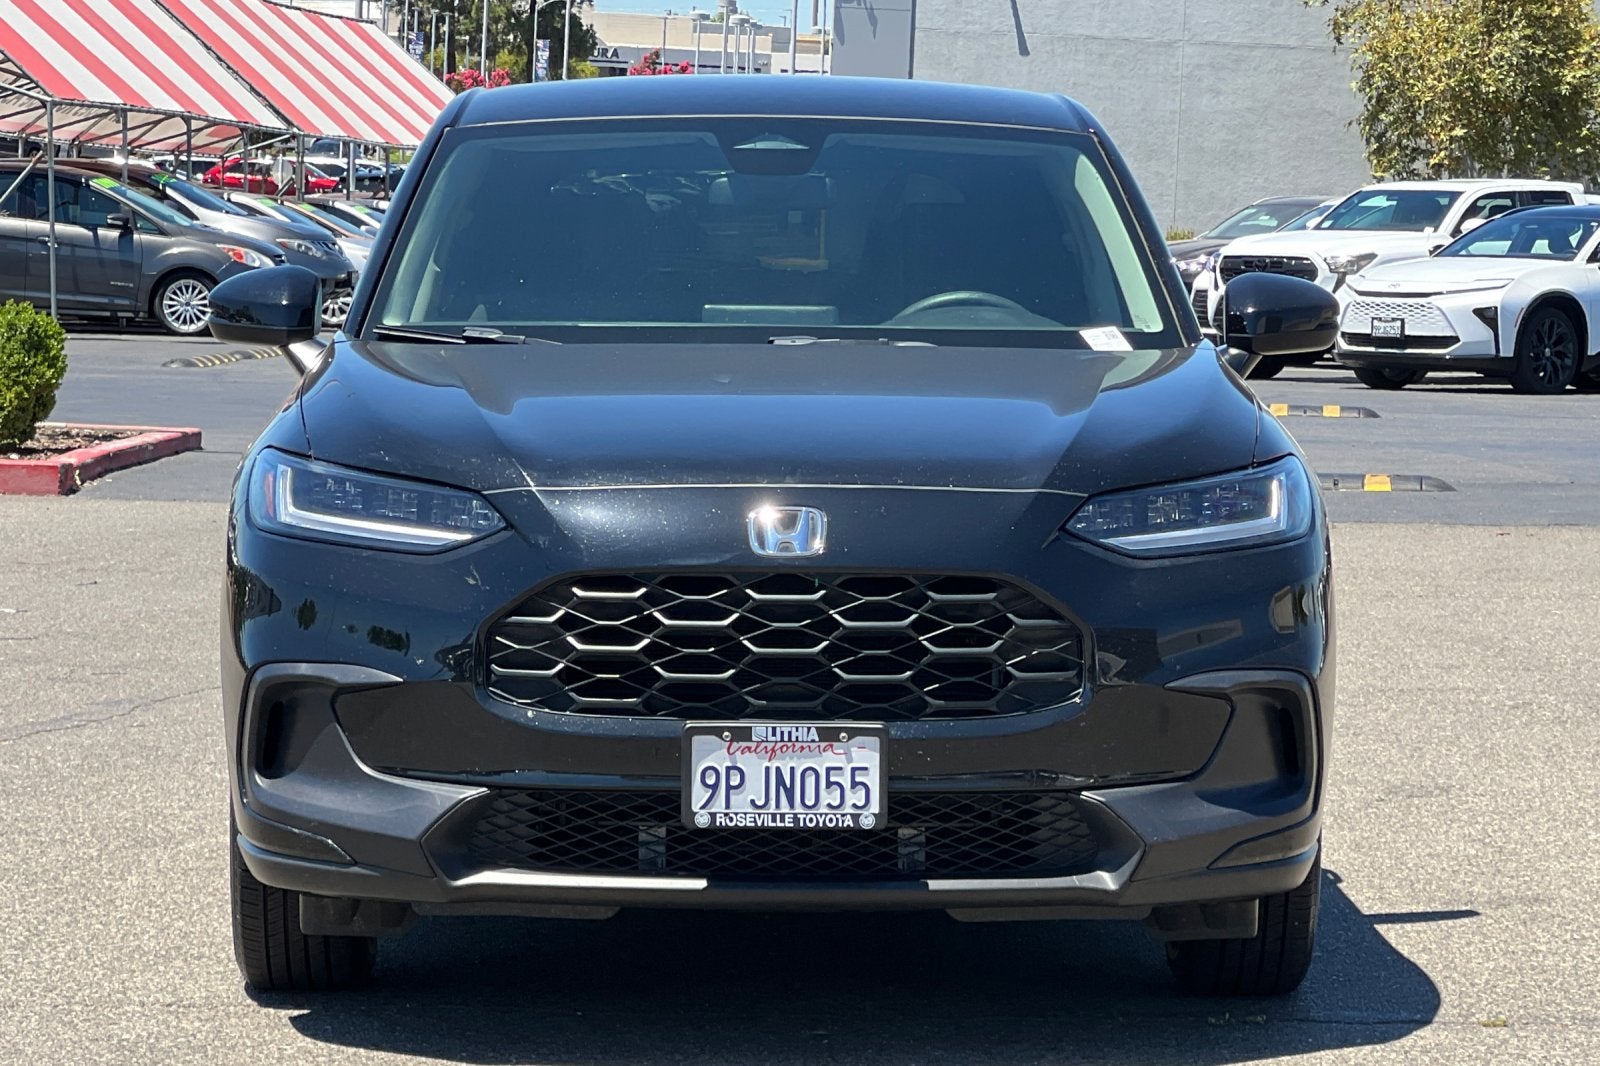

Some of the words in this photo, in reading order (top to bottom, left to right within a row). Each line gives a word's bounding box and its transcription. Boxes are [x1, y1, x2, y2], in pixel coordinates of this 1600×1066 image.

[767, 726, 820, 742] LITHIA
[726, 739, 848, 762] California
[699, 765, 872, 810] 9PJN055
[716, 813, 794, 828] ROSEVILLE
[798, 814, 854, 828] TOYOTA
